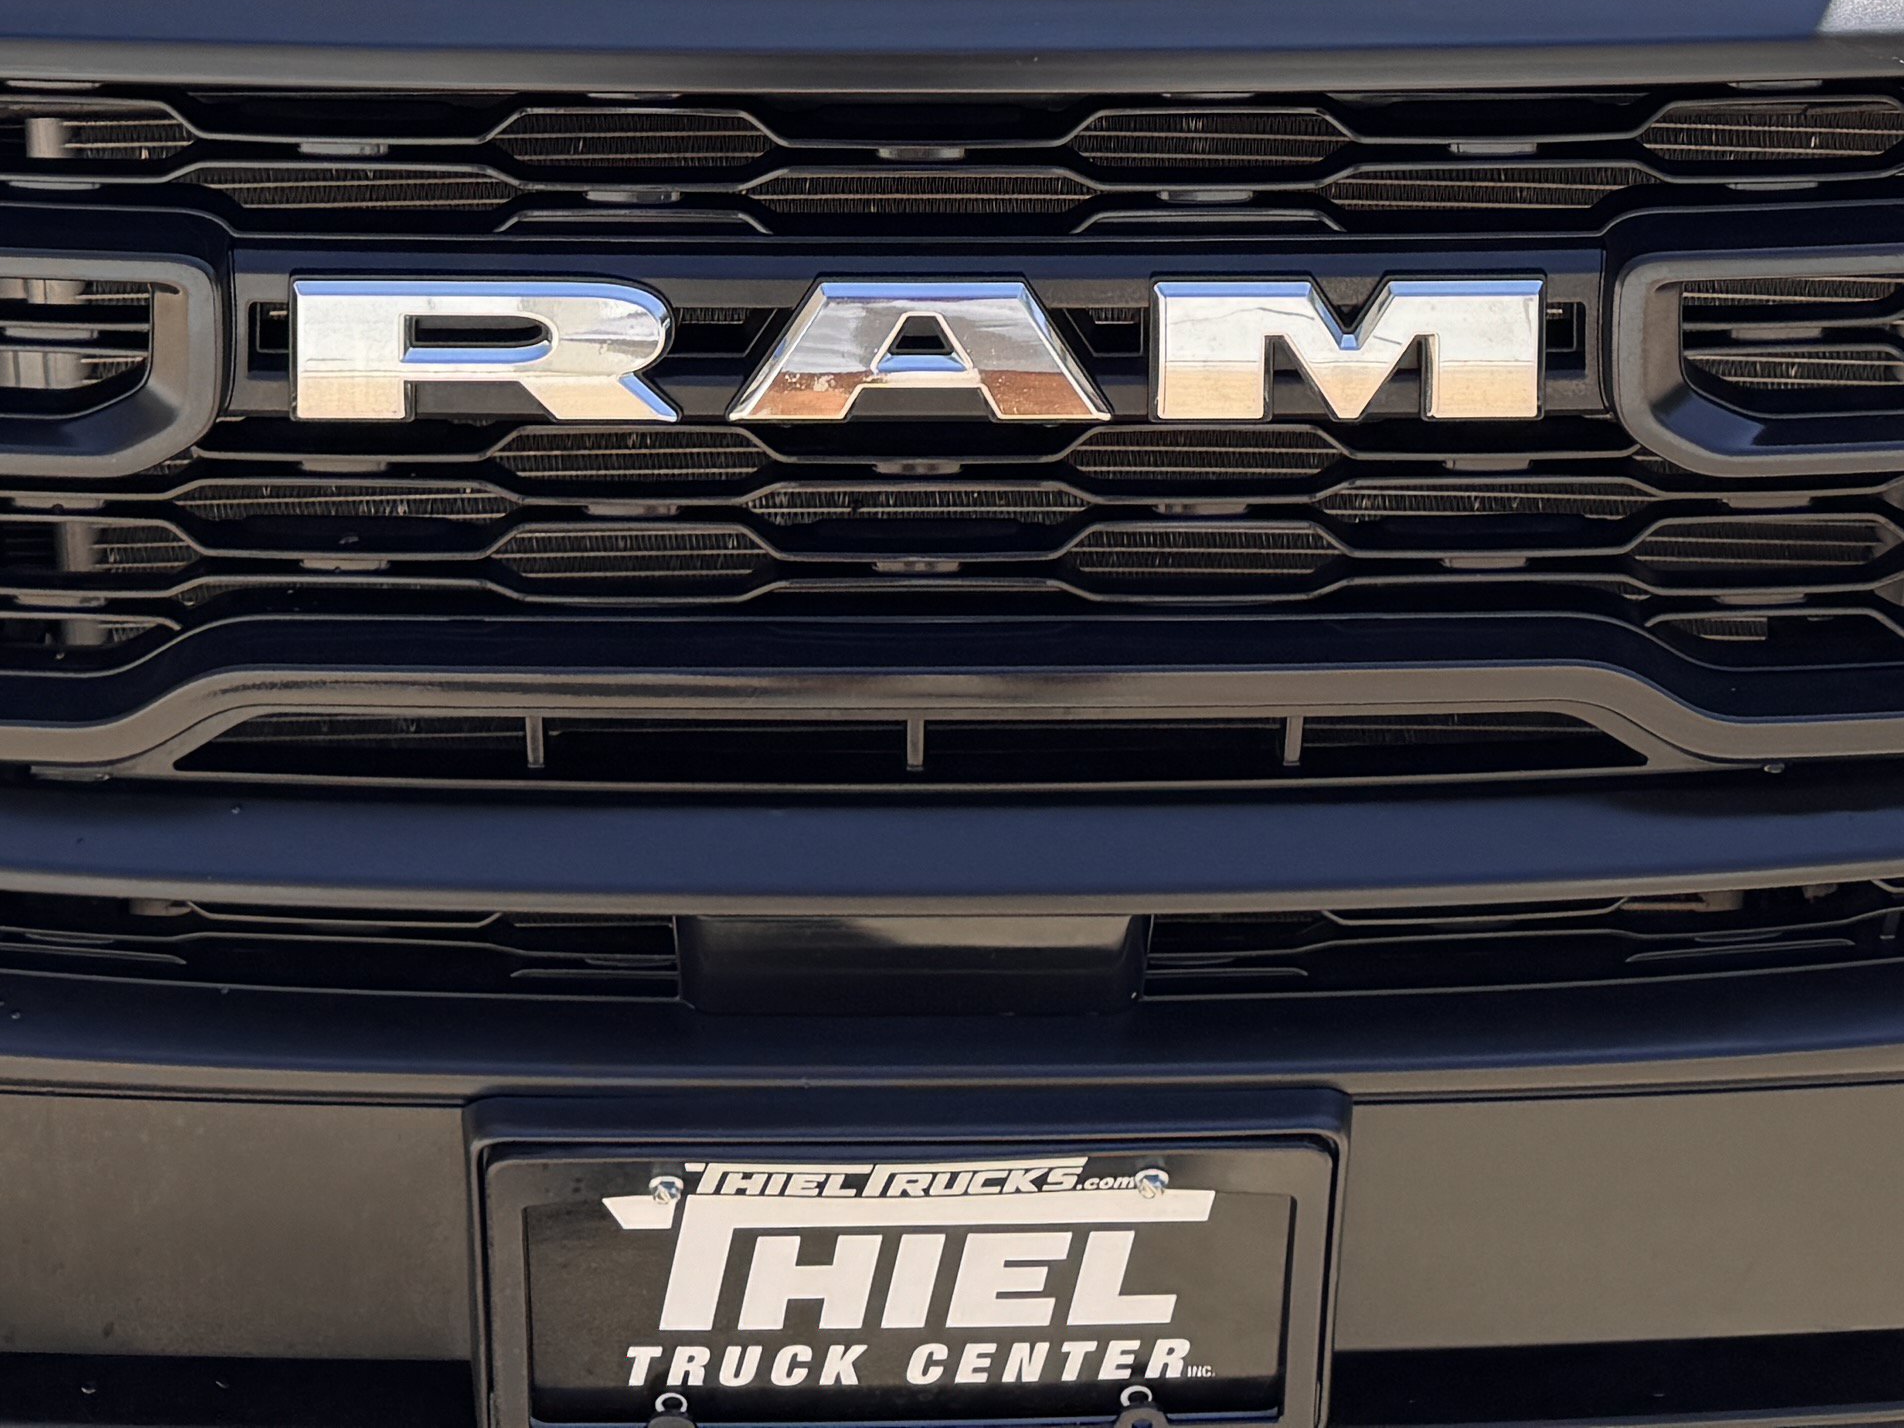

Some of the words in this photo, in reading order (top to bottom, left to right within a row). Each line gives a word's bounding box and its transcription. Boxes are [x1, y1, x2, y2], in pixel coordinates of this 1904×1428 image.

[295, 280, 1544, 422] RAM
[602, 1190, 1216, 1332] THIEL
[626, 1343, 872, 1388] TRUCK
[906, 1338, 1191, 1384] CENTER
[1186, 1365, 1216, 1378] INC.
